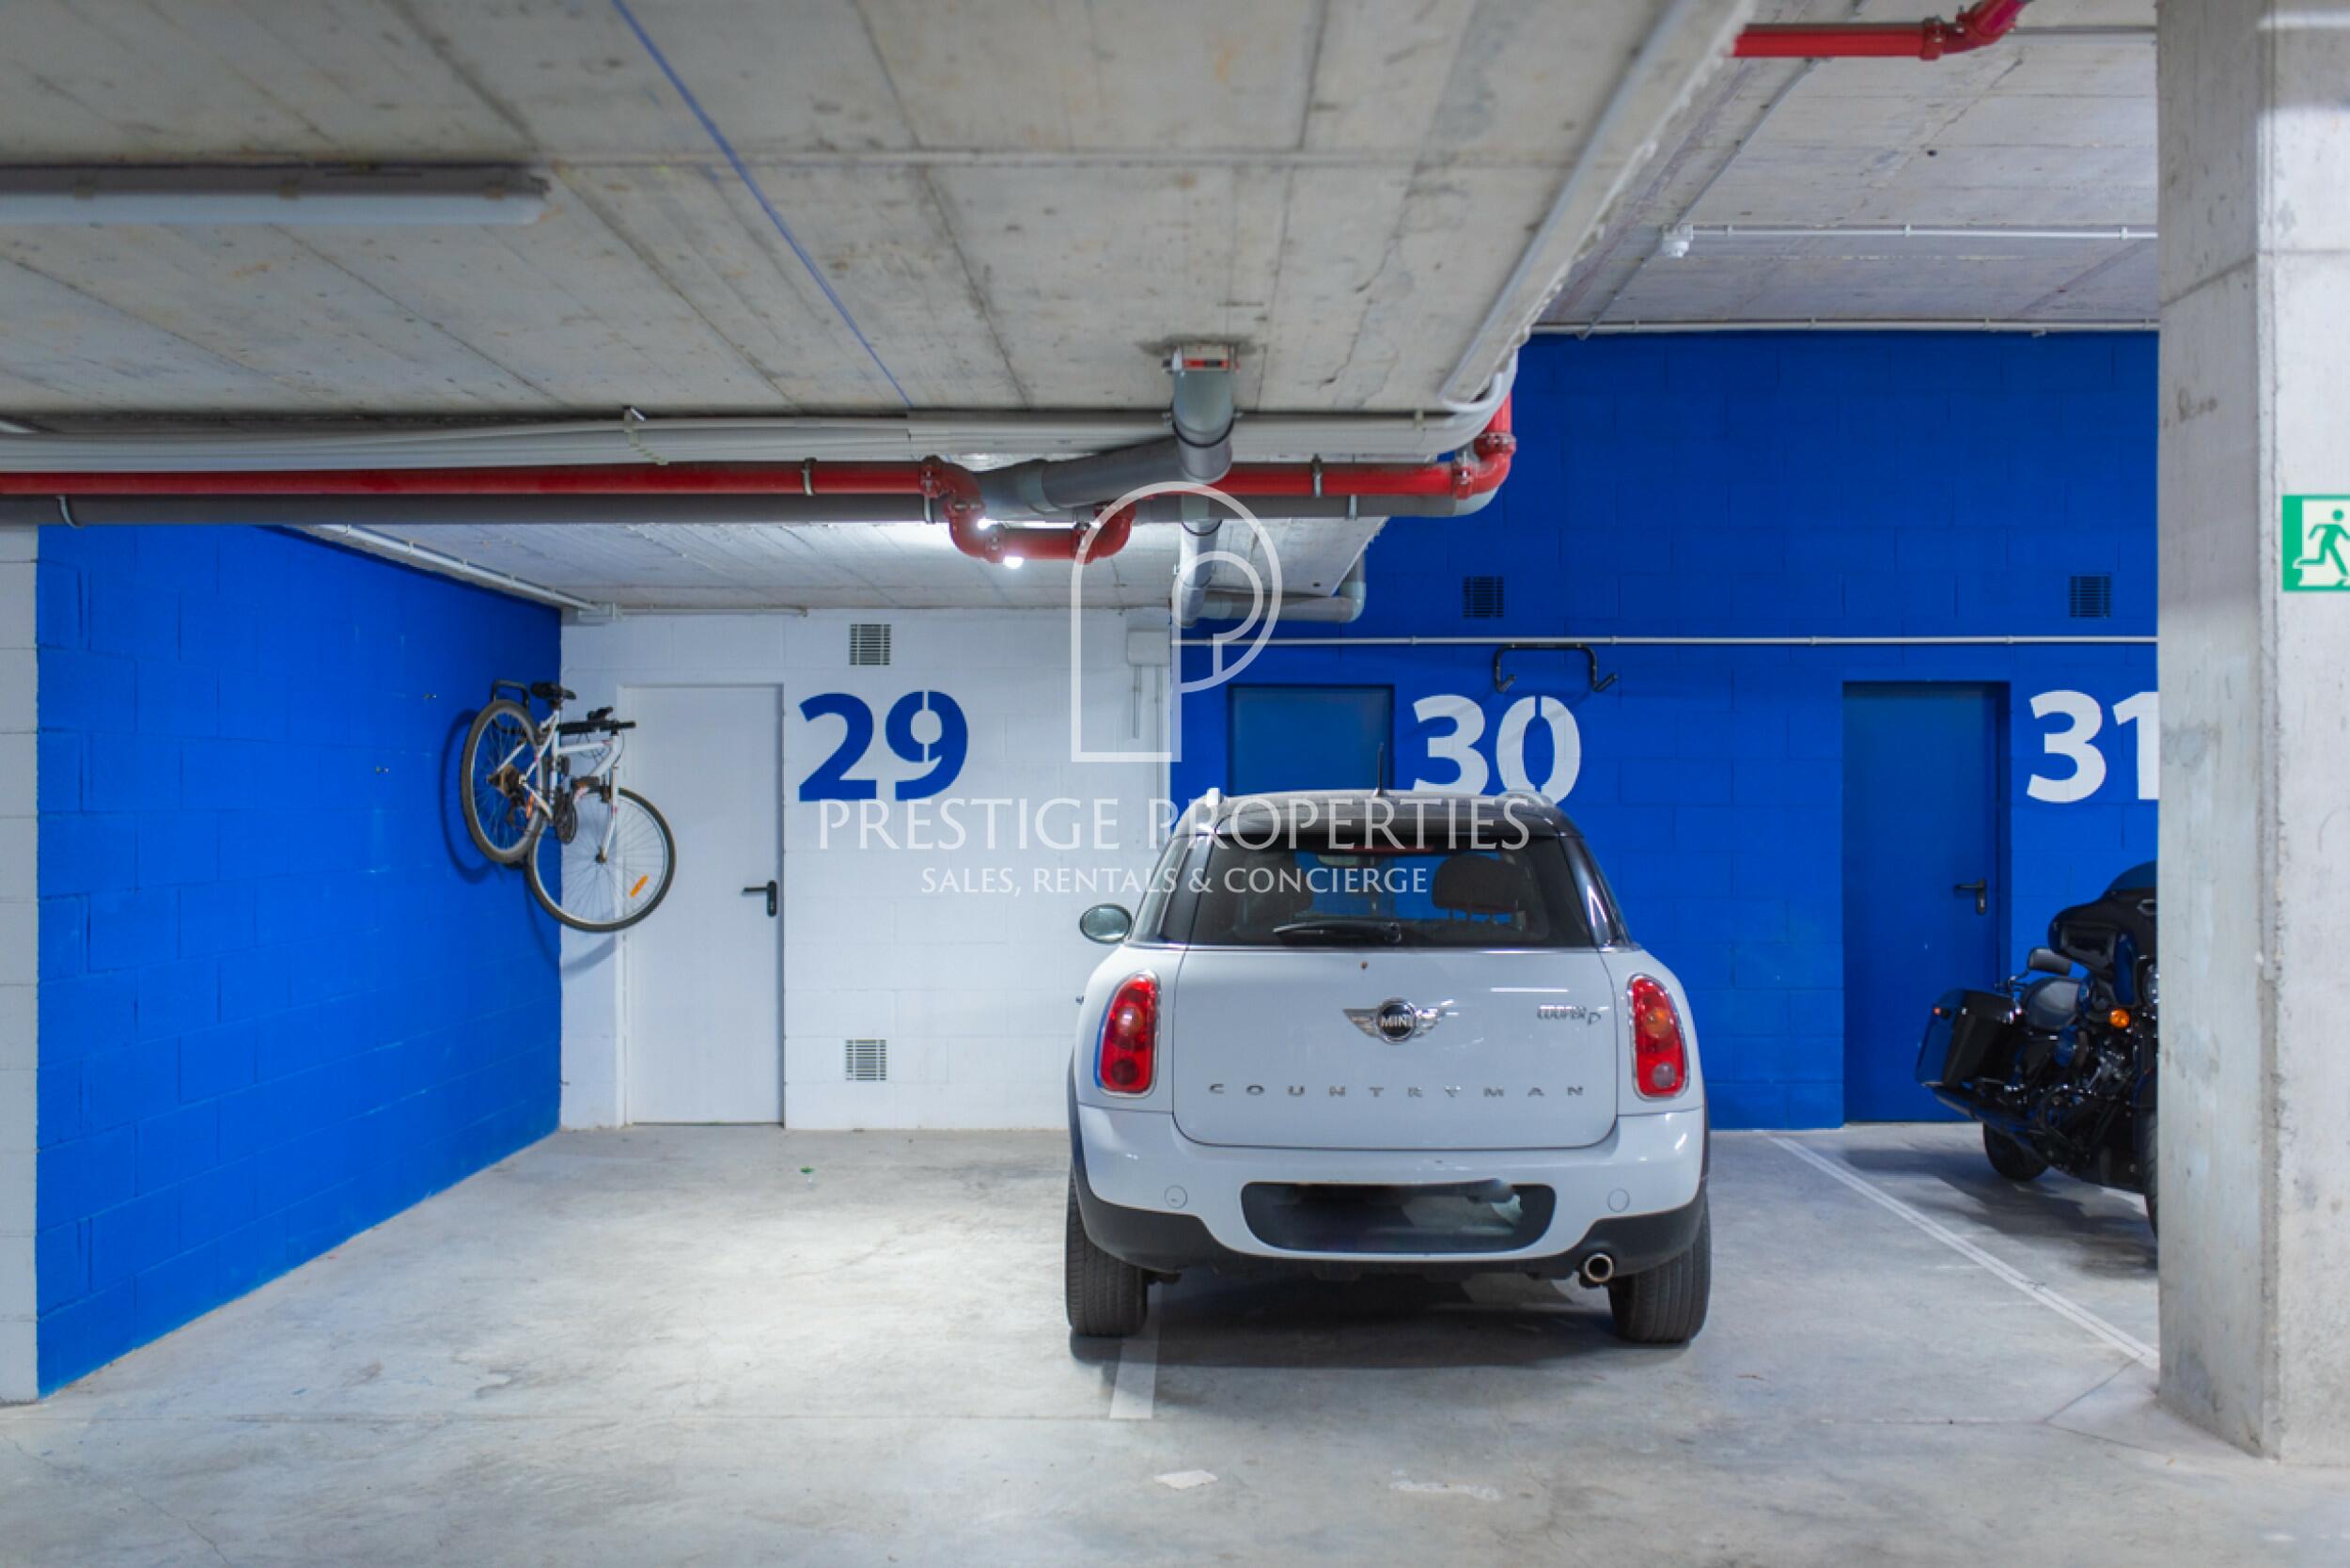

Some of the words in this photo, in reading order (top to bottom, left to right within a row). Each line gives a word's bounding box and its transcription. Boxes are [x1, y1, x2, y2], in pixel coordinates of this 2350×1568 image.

[798, 690, 968, 802] 29
[1412, 694, 1582, 805] 30
[2027, 690, 2159, 804] 31
[1380, 1014, 1415, 1027] MINI
[1209, 1082, 1584, 1098] COUNTRYMAN
